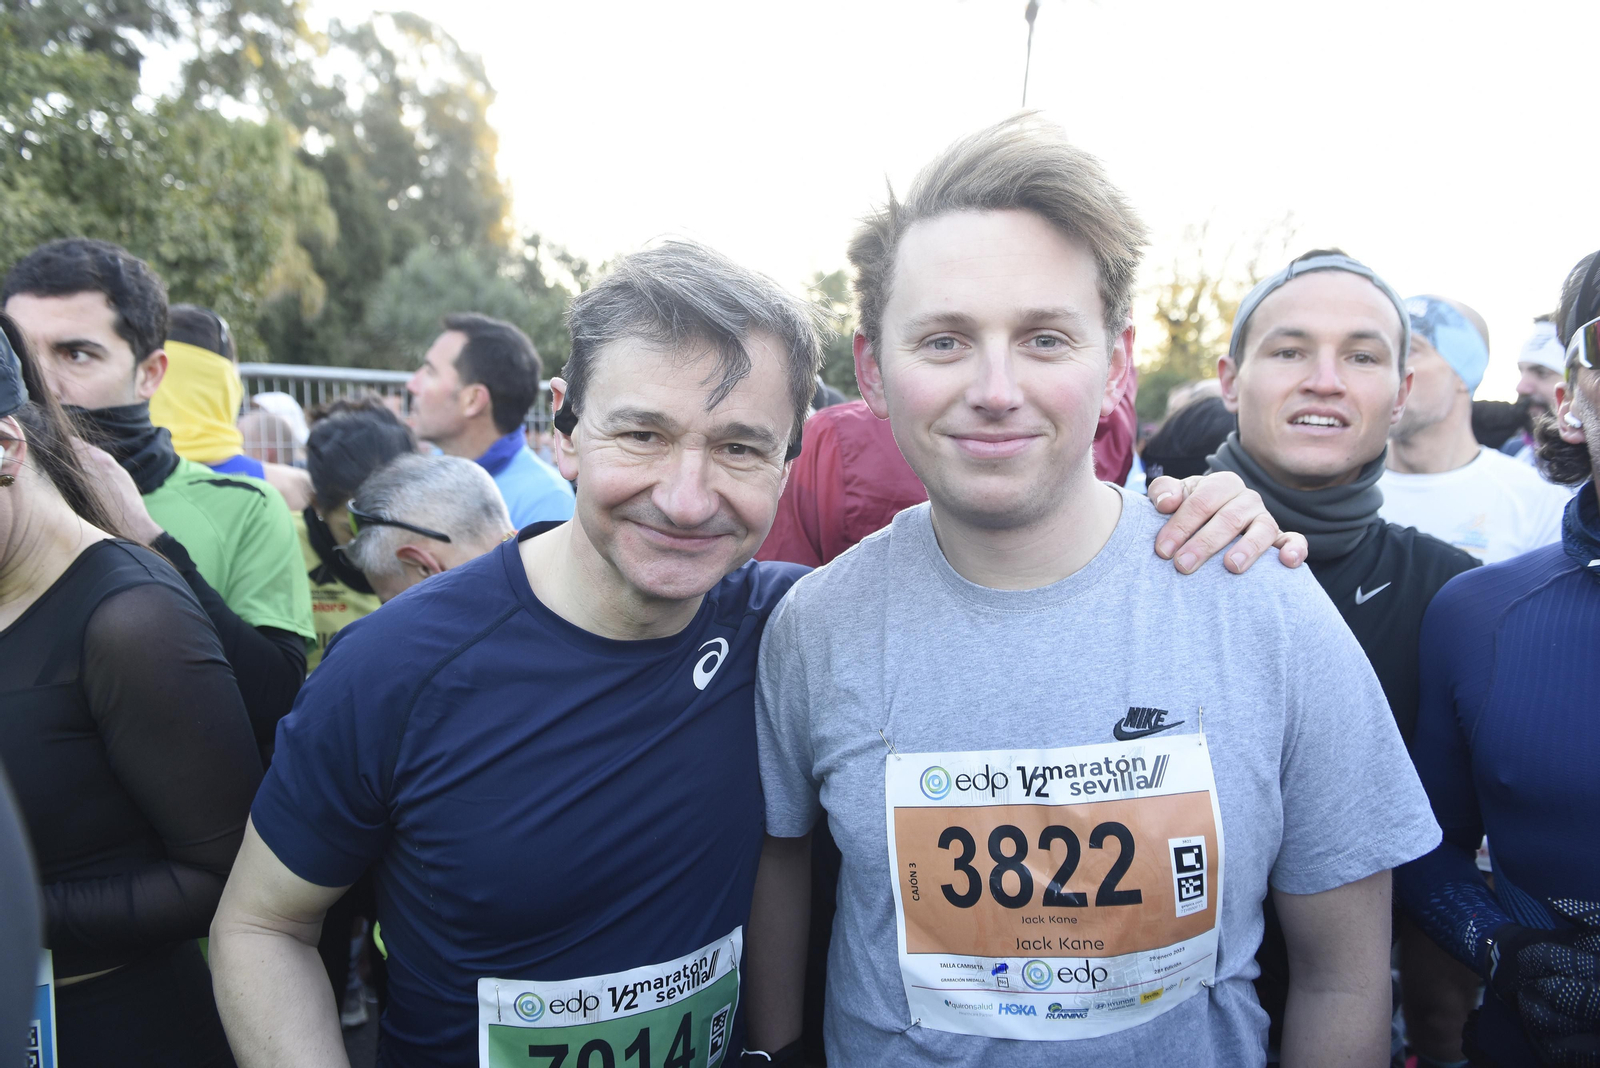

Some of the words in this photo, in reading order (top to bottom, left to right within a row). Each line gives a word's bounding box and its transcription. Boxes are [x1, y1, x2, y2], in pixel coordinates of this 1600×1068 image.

[1122, 706, 1169, 730] NIKE
[955, 764, 1009, 798] edp
[1042, 754, 1147, 780] maratón
[1069, 769, 1150, 797] sevilla
[937, 821, 1143, 909] 3822
[908, 870, 920, 902] CAJÓN
[1021, 915, 1045, 925] Jack
[1048, 915, 1078, 925] Kane
[1016, 936, 1053, 951] Jack
[1058, 937, 1105, 951] Kane
[549, 989, 600, 1018] edp
[633, 956, 708, 994] maratón
[656, 970, 710, 1003] sevilla
[1057, 960, 1108, 990] edp
[998, 1003, 1038, 1017] HOKA
[1045, 1012, 1088, 1020] RUNNING
